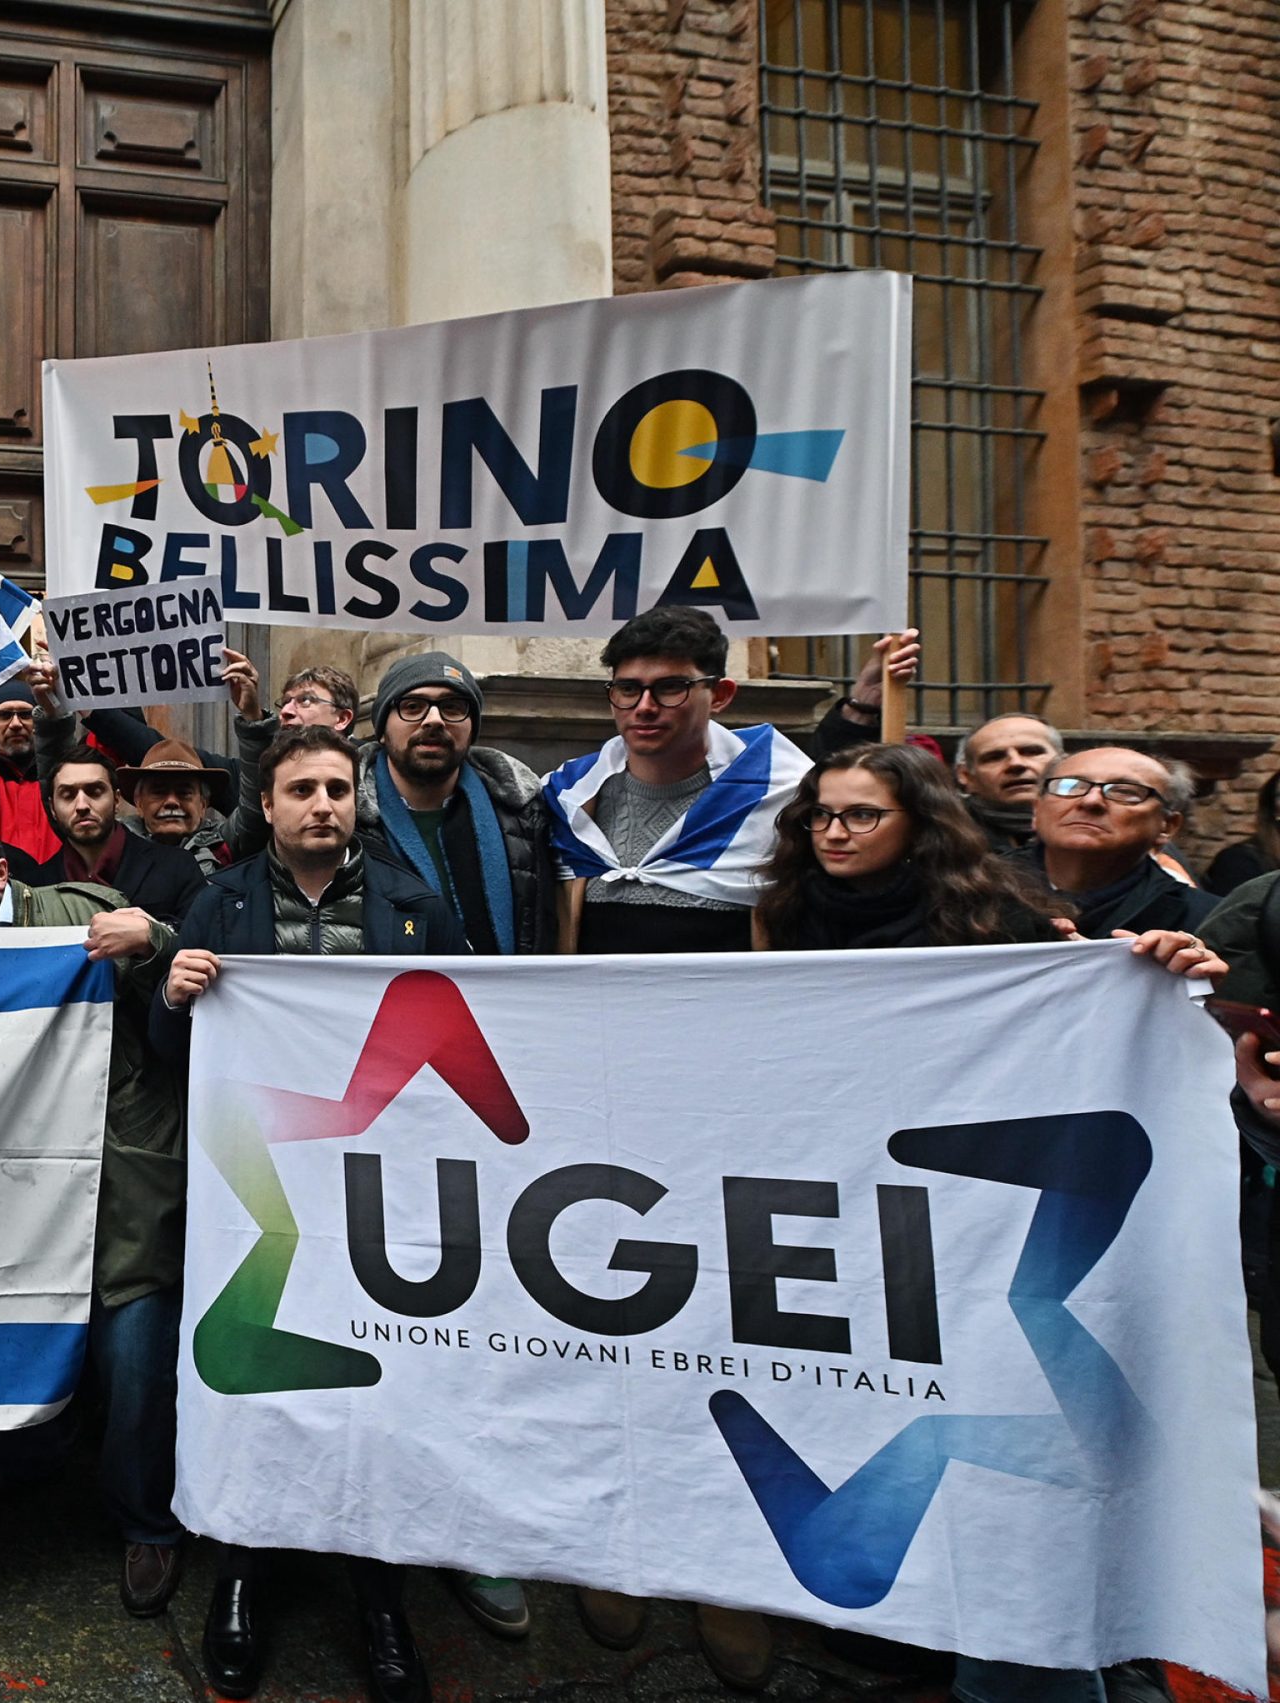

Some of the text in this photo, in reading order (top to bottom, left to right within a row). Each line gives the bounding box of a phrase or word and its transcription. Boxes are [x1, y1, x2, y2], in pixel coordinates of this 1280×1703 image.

[113, 367, 758, 530] TORINO
[49, 588, 221, 641] VERGOGNA
[94, 522, 760, 622] BELLISSIMA
[58, 634, 226, 699] RETTORE
[343, 1152, 942, 1365] UGEI
[350, 1319, 947, 1401] UNIONE GIOVANI EBREI D'ITALIA
